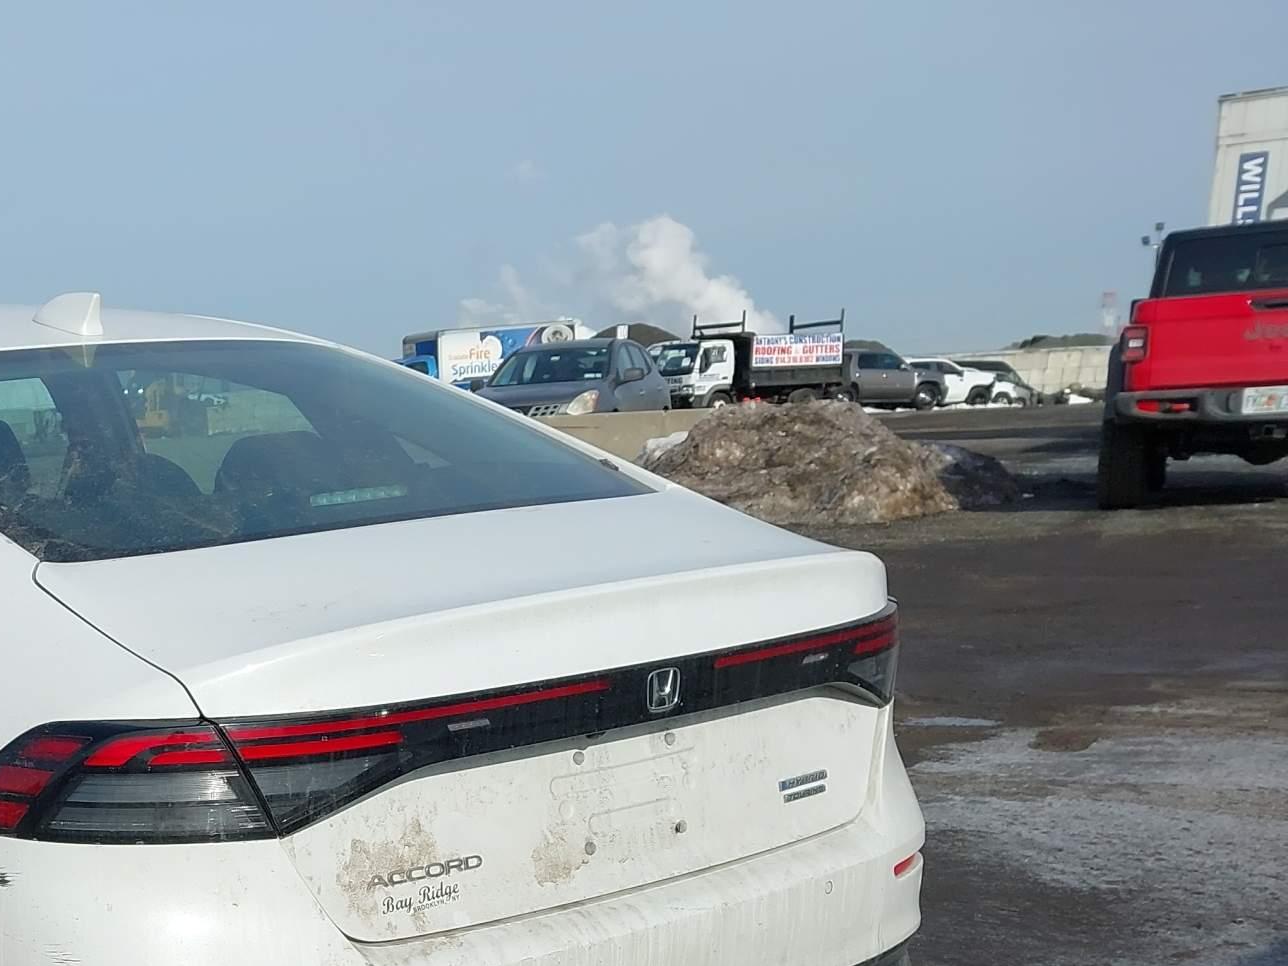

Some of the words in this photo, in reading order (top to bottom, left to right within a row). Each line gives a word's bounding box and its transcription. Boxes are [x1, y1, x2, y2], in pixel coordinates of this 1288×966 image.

[469, 346, 490, 360] Fire
[755, 346, 792, 355] ROOFING
[802, 344, 840, 354] GUTTERS
[367, 855, 483, 890] ACCORD
[382, 896, 413, 915] Bay
[418, 881, 460, 904] Ridge
[452, 894, 460, 902] NY
